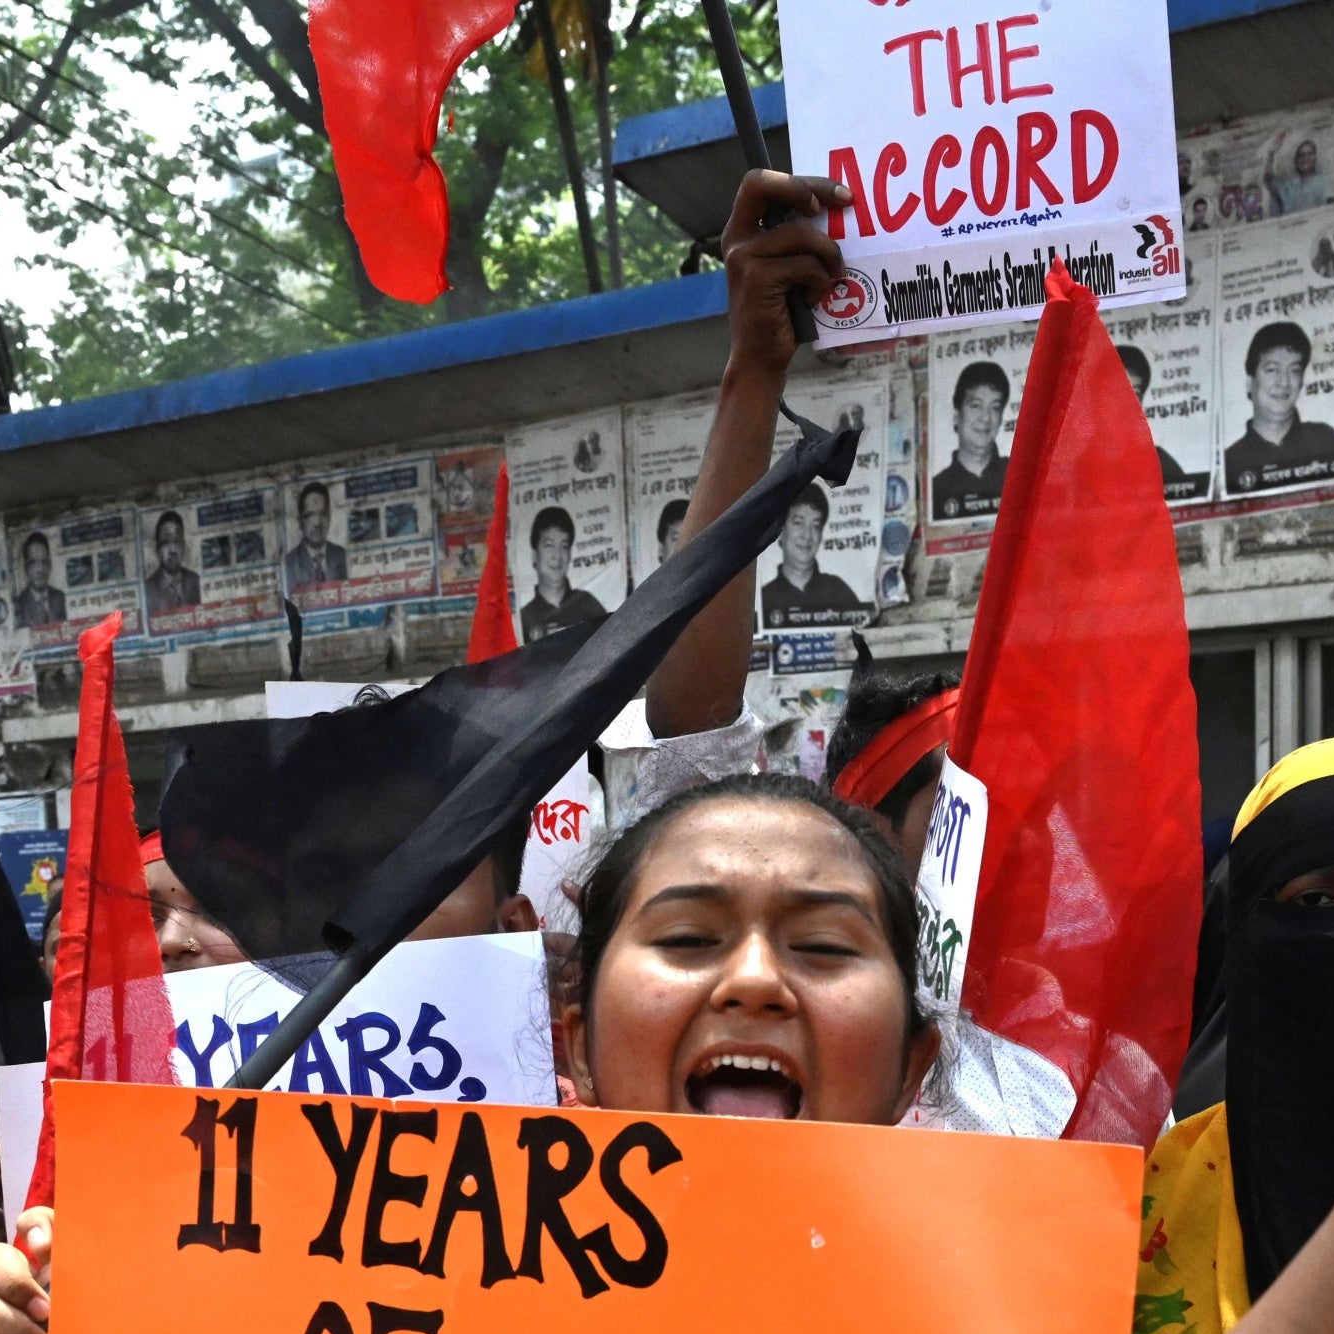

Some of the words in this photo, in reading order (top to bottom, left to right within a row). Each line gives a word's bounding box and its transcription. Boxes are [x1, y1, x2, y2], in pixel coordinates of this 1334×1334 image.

[884, 14, 1054, 117] THE
[827, 109, 1119, 240] ACCORD
[834, 316, 861, 327] SGSF
[881, 262, 943, 324] Sommilito
[943, 254, 1003, 317] Garments
[1003, 248, 1046, 309] Sramik
[176, 1096, 261, 1255] 11
[301, 1100, 684, 1299] YEARS
